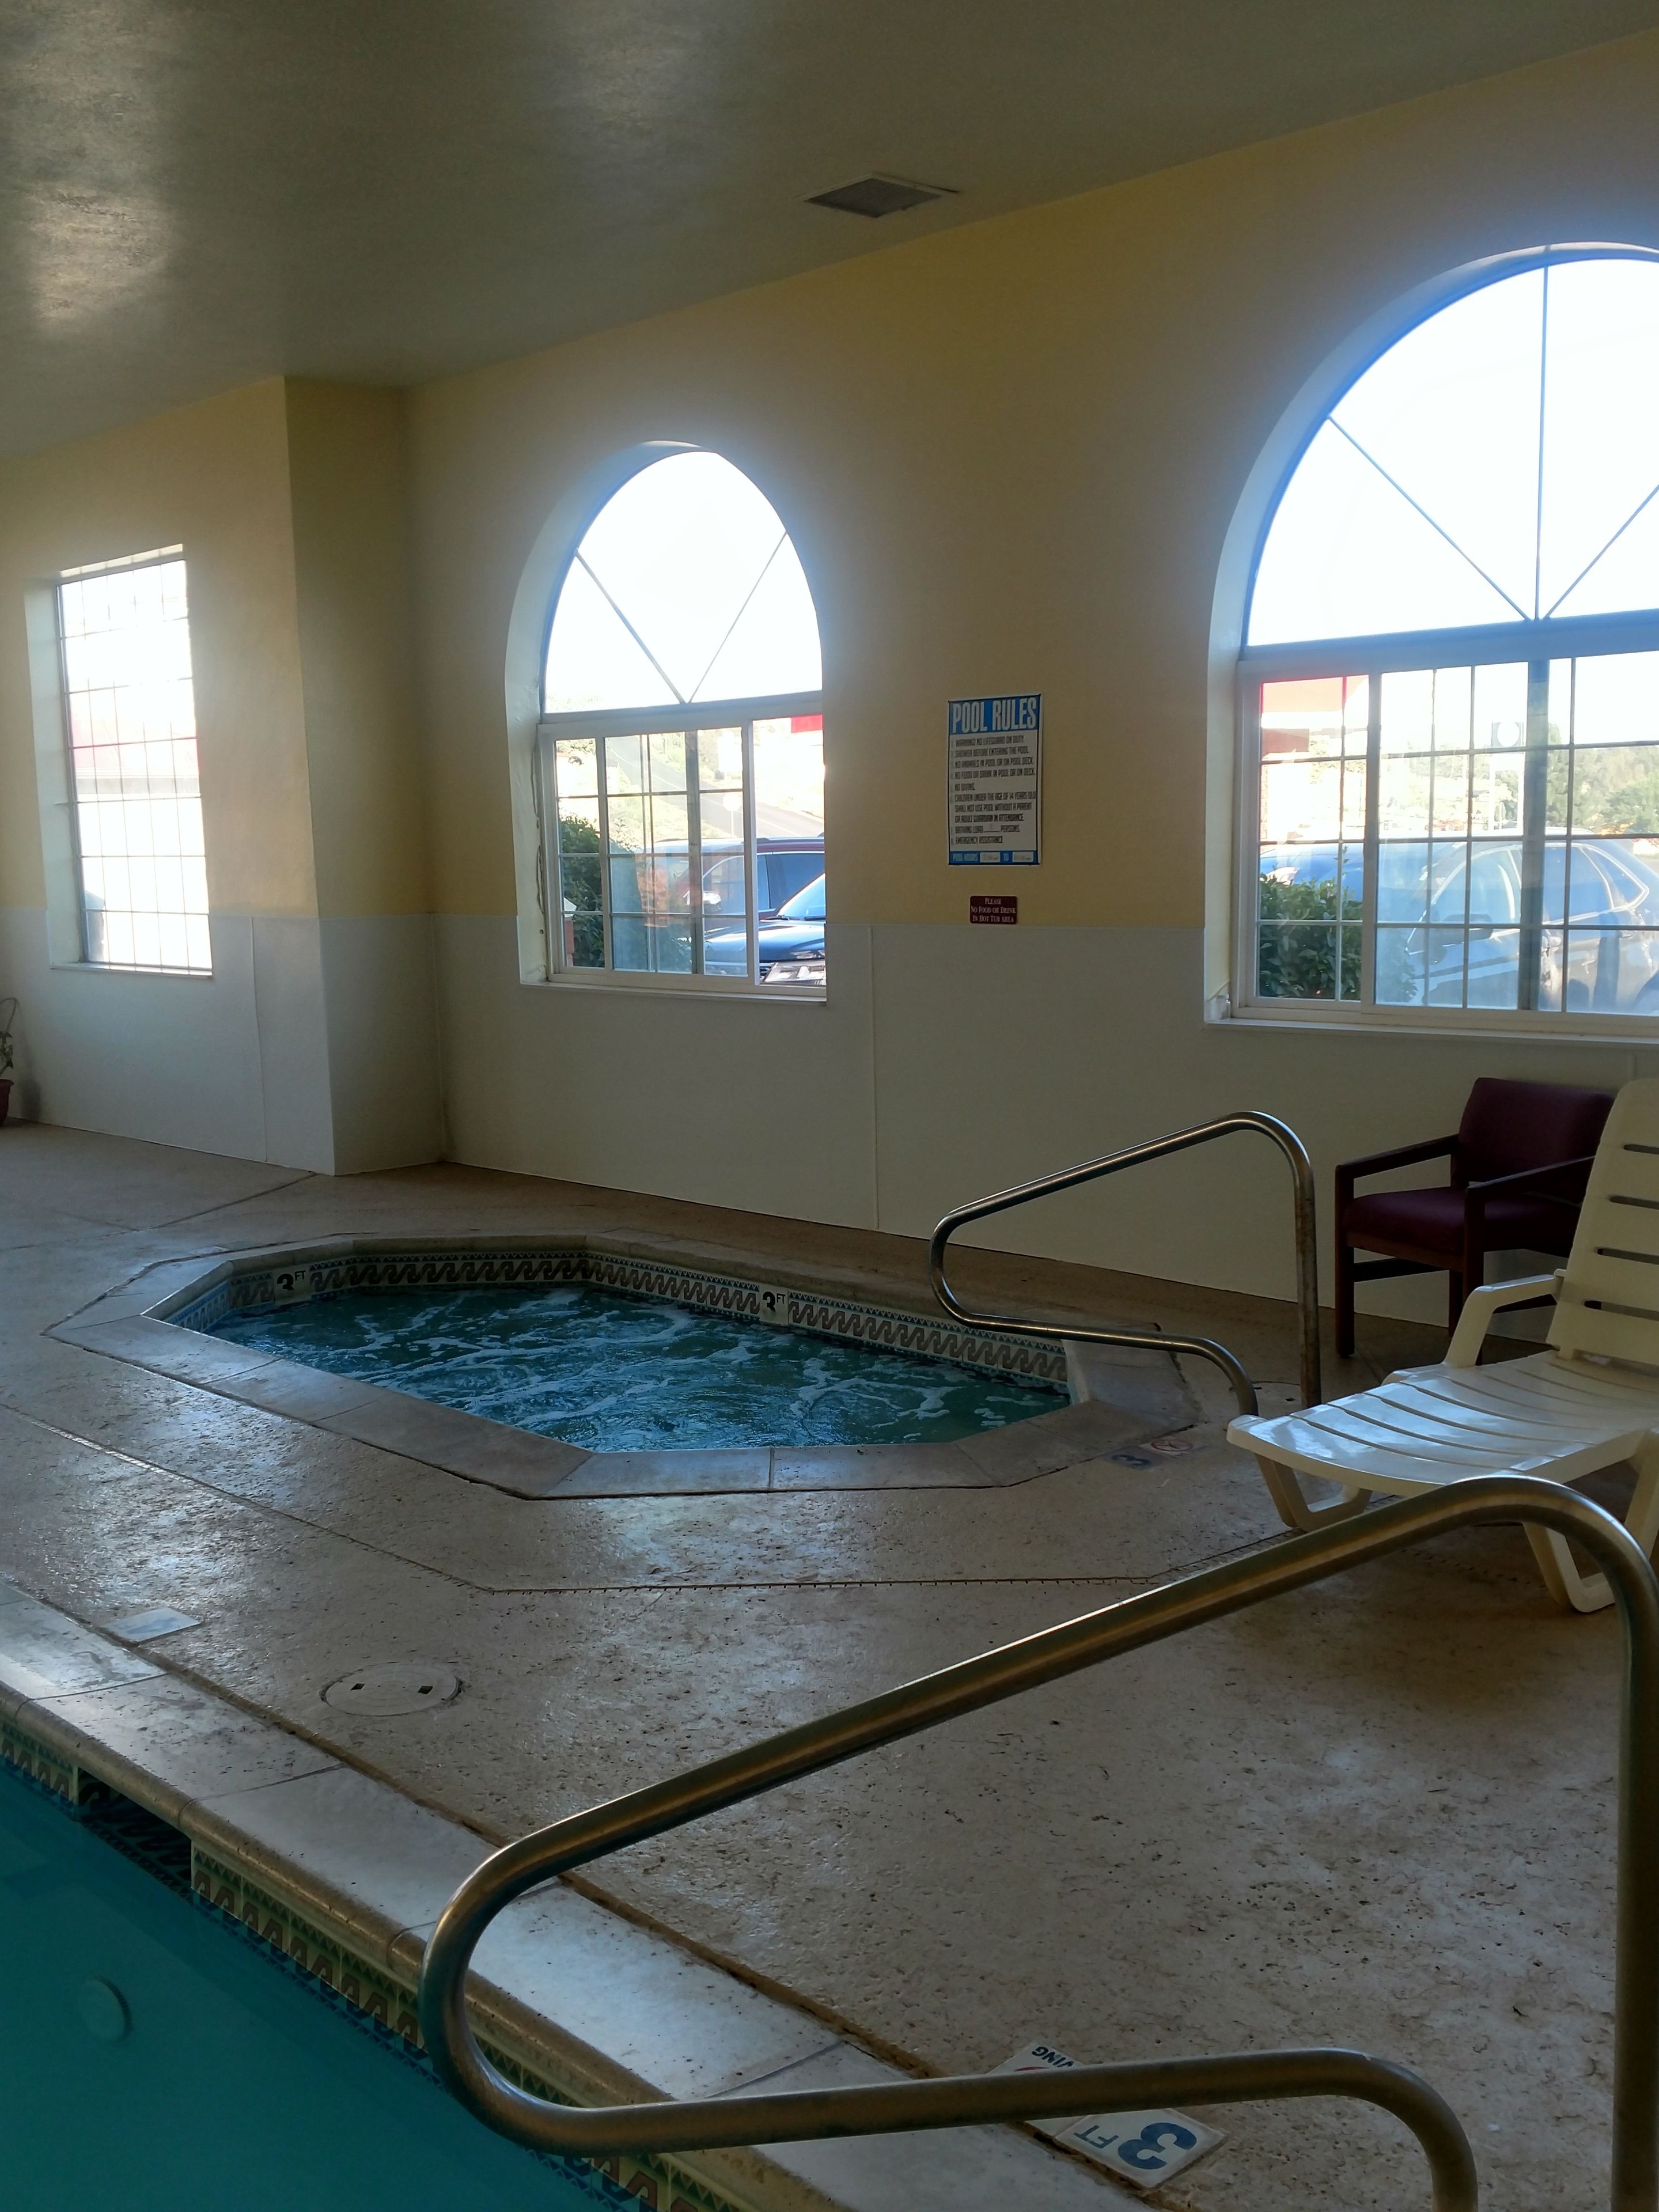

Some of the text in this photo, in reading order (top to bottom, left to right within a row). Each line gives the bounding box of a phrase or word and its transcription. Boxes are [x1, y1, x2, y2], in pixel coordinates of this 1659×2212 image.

[952, 698, 1037, 733] POOL RULES
[294, 1270, 306, 1281] FT
[777, 1293, 786, 1304] FT
[1032, 2046, 1075, 2068] VING
[1073, 2122, 1198, 2170] 3 FT
